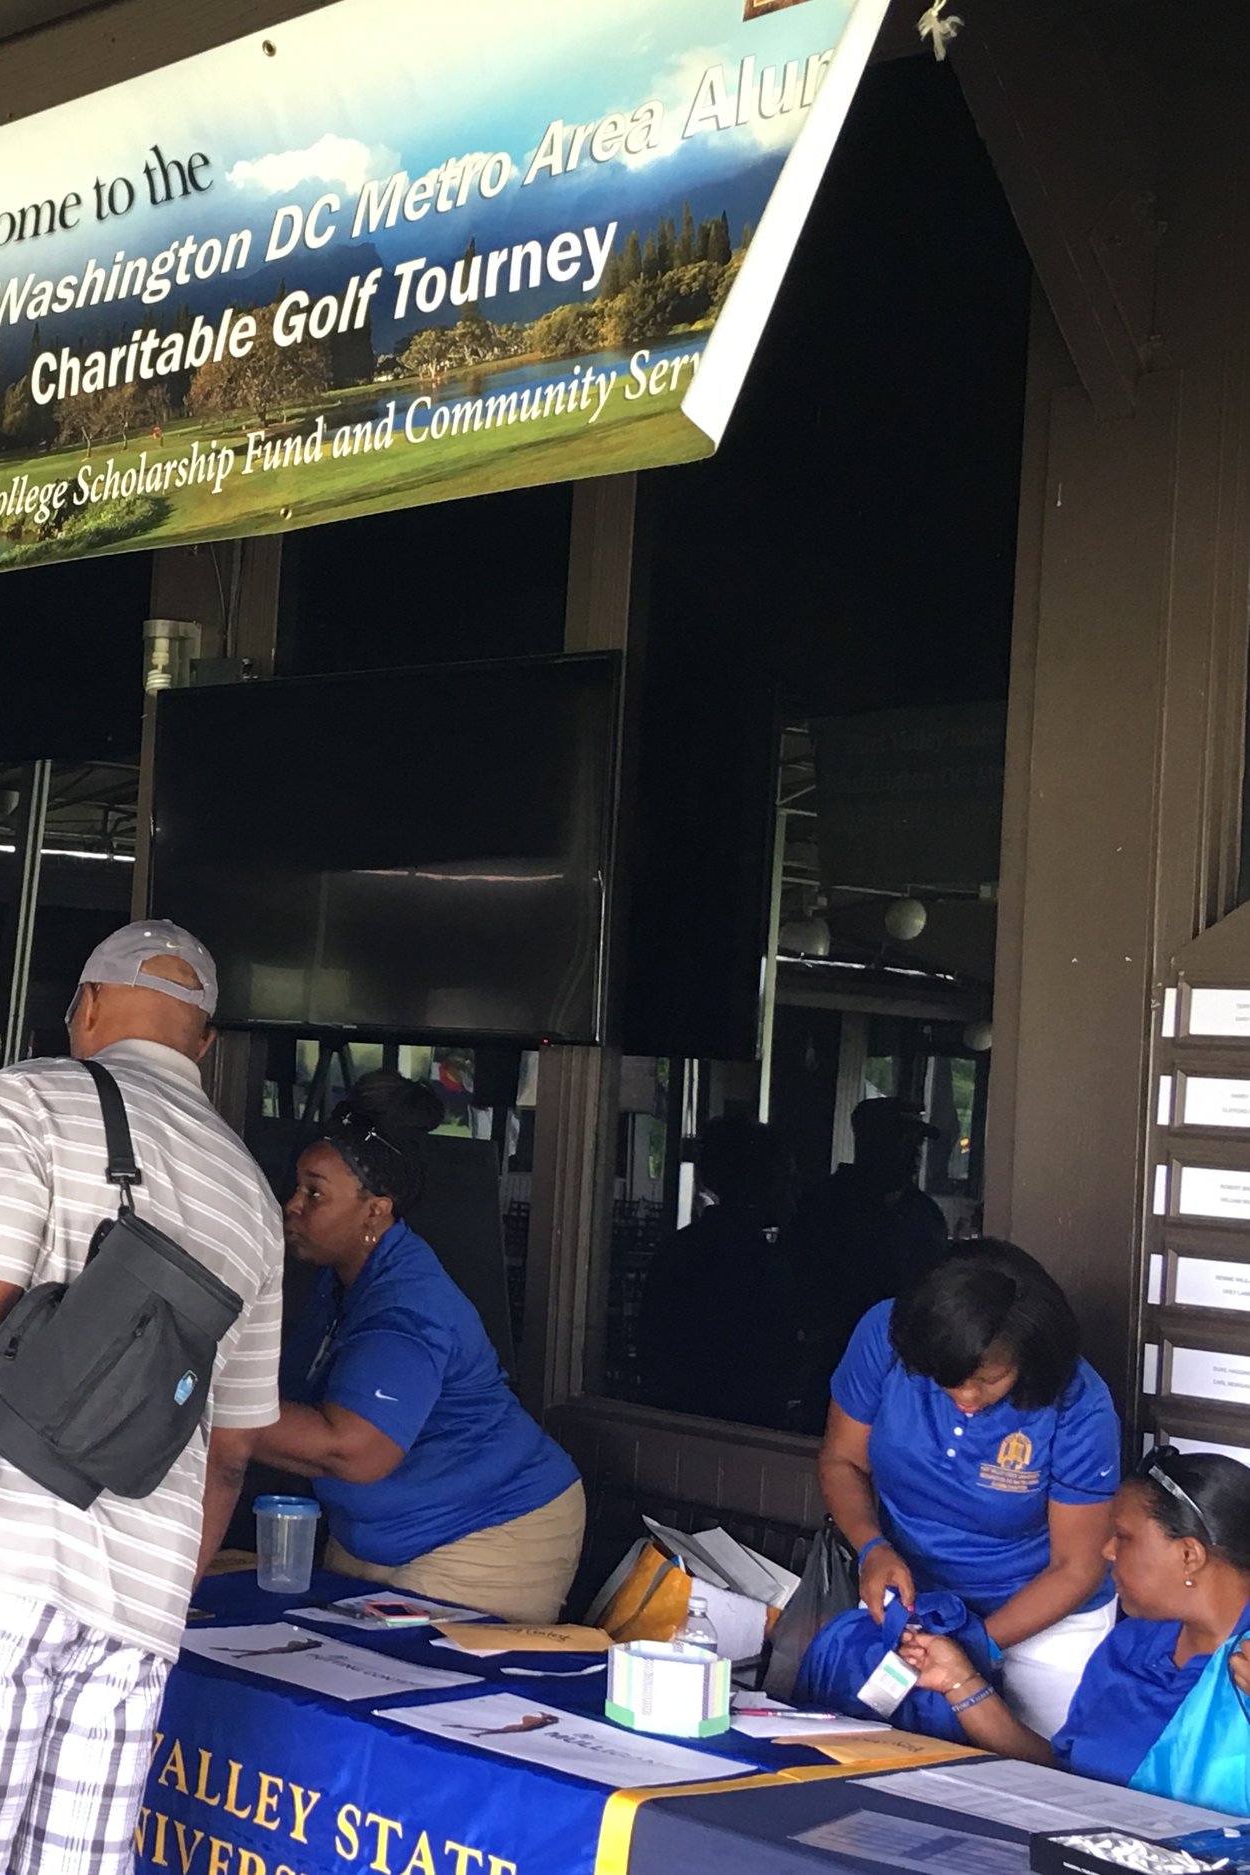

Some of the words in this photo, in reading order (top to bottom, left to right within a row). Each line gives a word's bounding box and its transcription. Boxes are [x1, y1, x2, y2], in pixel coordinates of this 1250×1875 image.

[93, 175, 135, 222] to
[143, 144, 214, 207] the
[264, 192, 340, 264] DC
[351, 150, 512, 238] Metro
[523, 99, 665, 187] Area
[31, 308, 257, 405] Charitable
[272, 266, 382, 349] Golf
[393, 221, 618, 320] Tourney
[73, 439, 235, 506] Scholarship
[241, 414, 326, 477] Fund
[332, 400, 395, 457] and
[404, 362, 617, 444] Community
[150, 1732, 321, 1844] ALLEY
